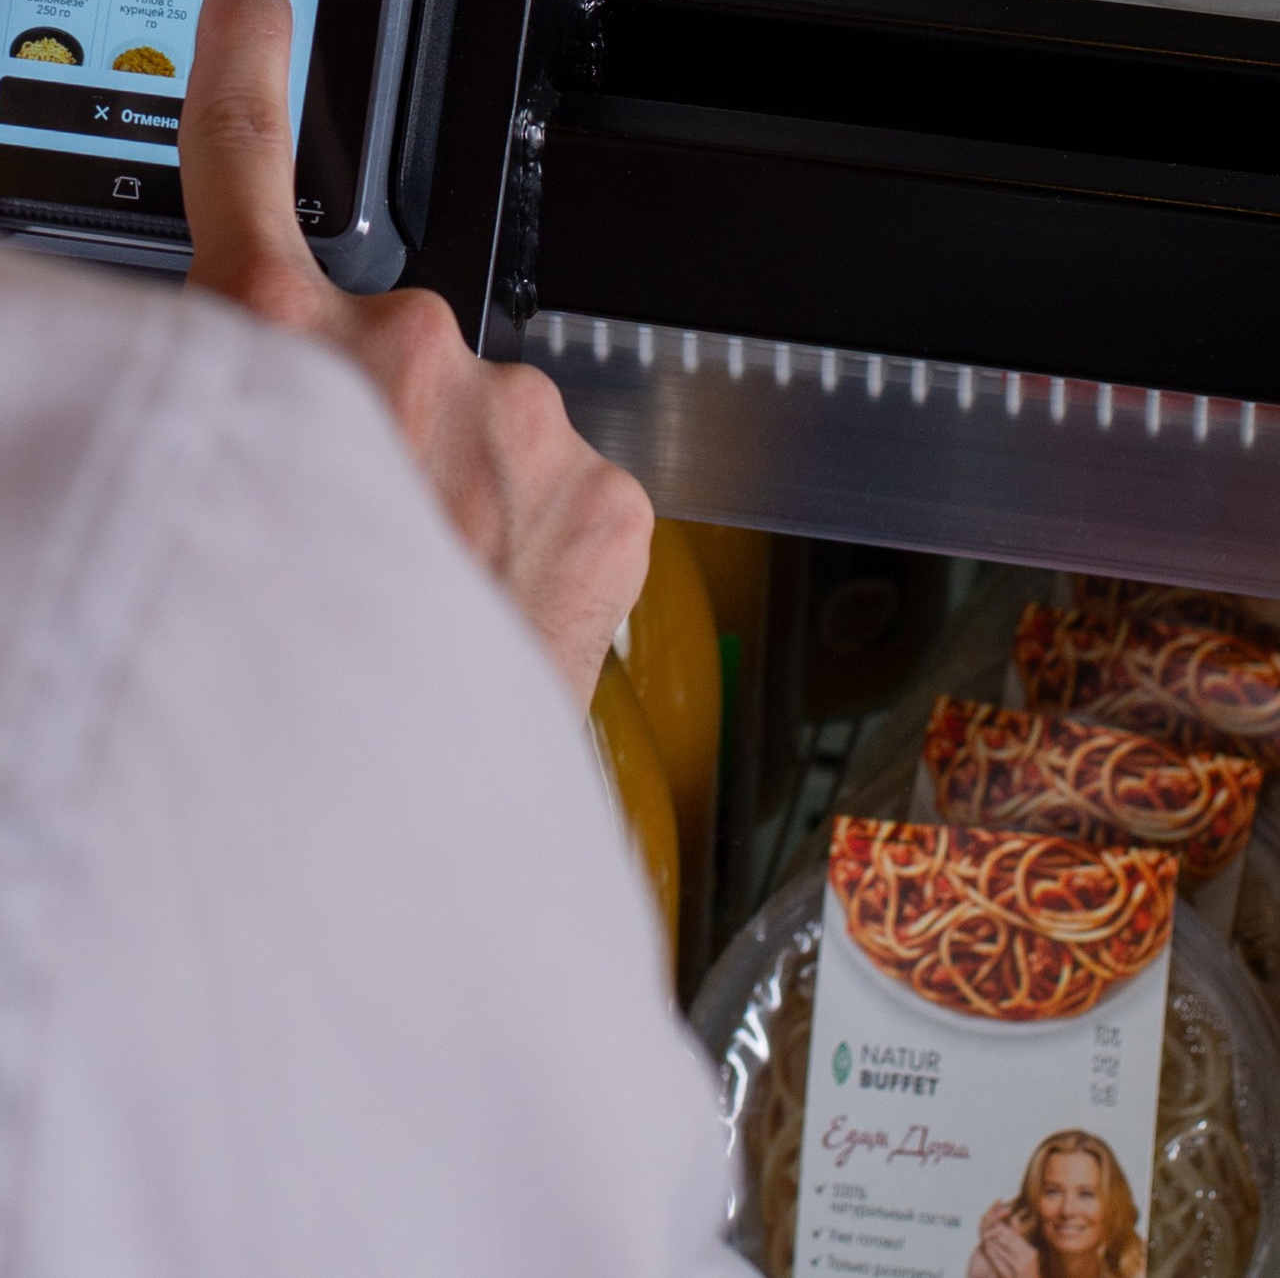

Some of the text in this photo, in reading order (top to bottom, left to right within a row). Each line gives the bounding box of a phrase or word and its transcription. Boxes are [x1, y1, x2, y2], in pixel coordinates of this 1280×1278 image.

[36, 5, 58, 17] 250
[120, 3, 187, 21] курицей 250
[121, 109, 179, 129] Отмена
[860, 1043, 941, 1073] NATUR
[858, 1069, 939, 1096] BUFFET
